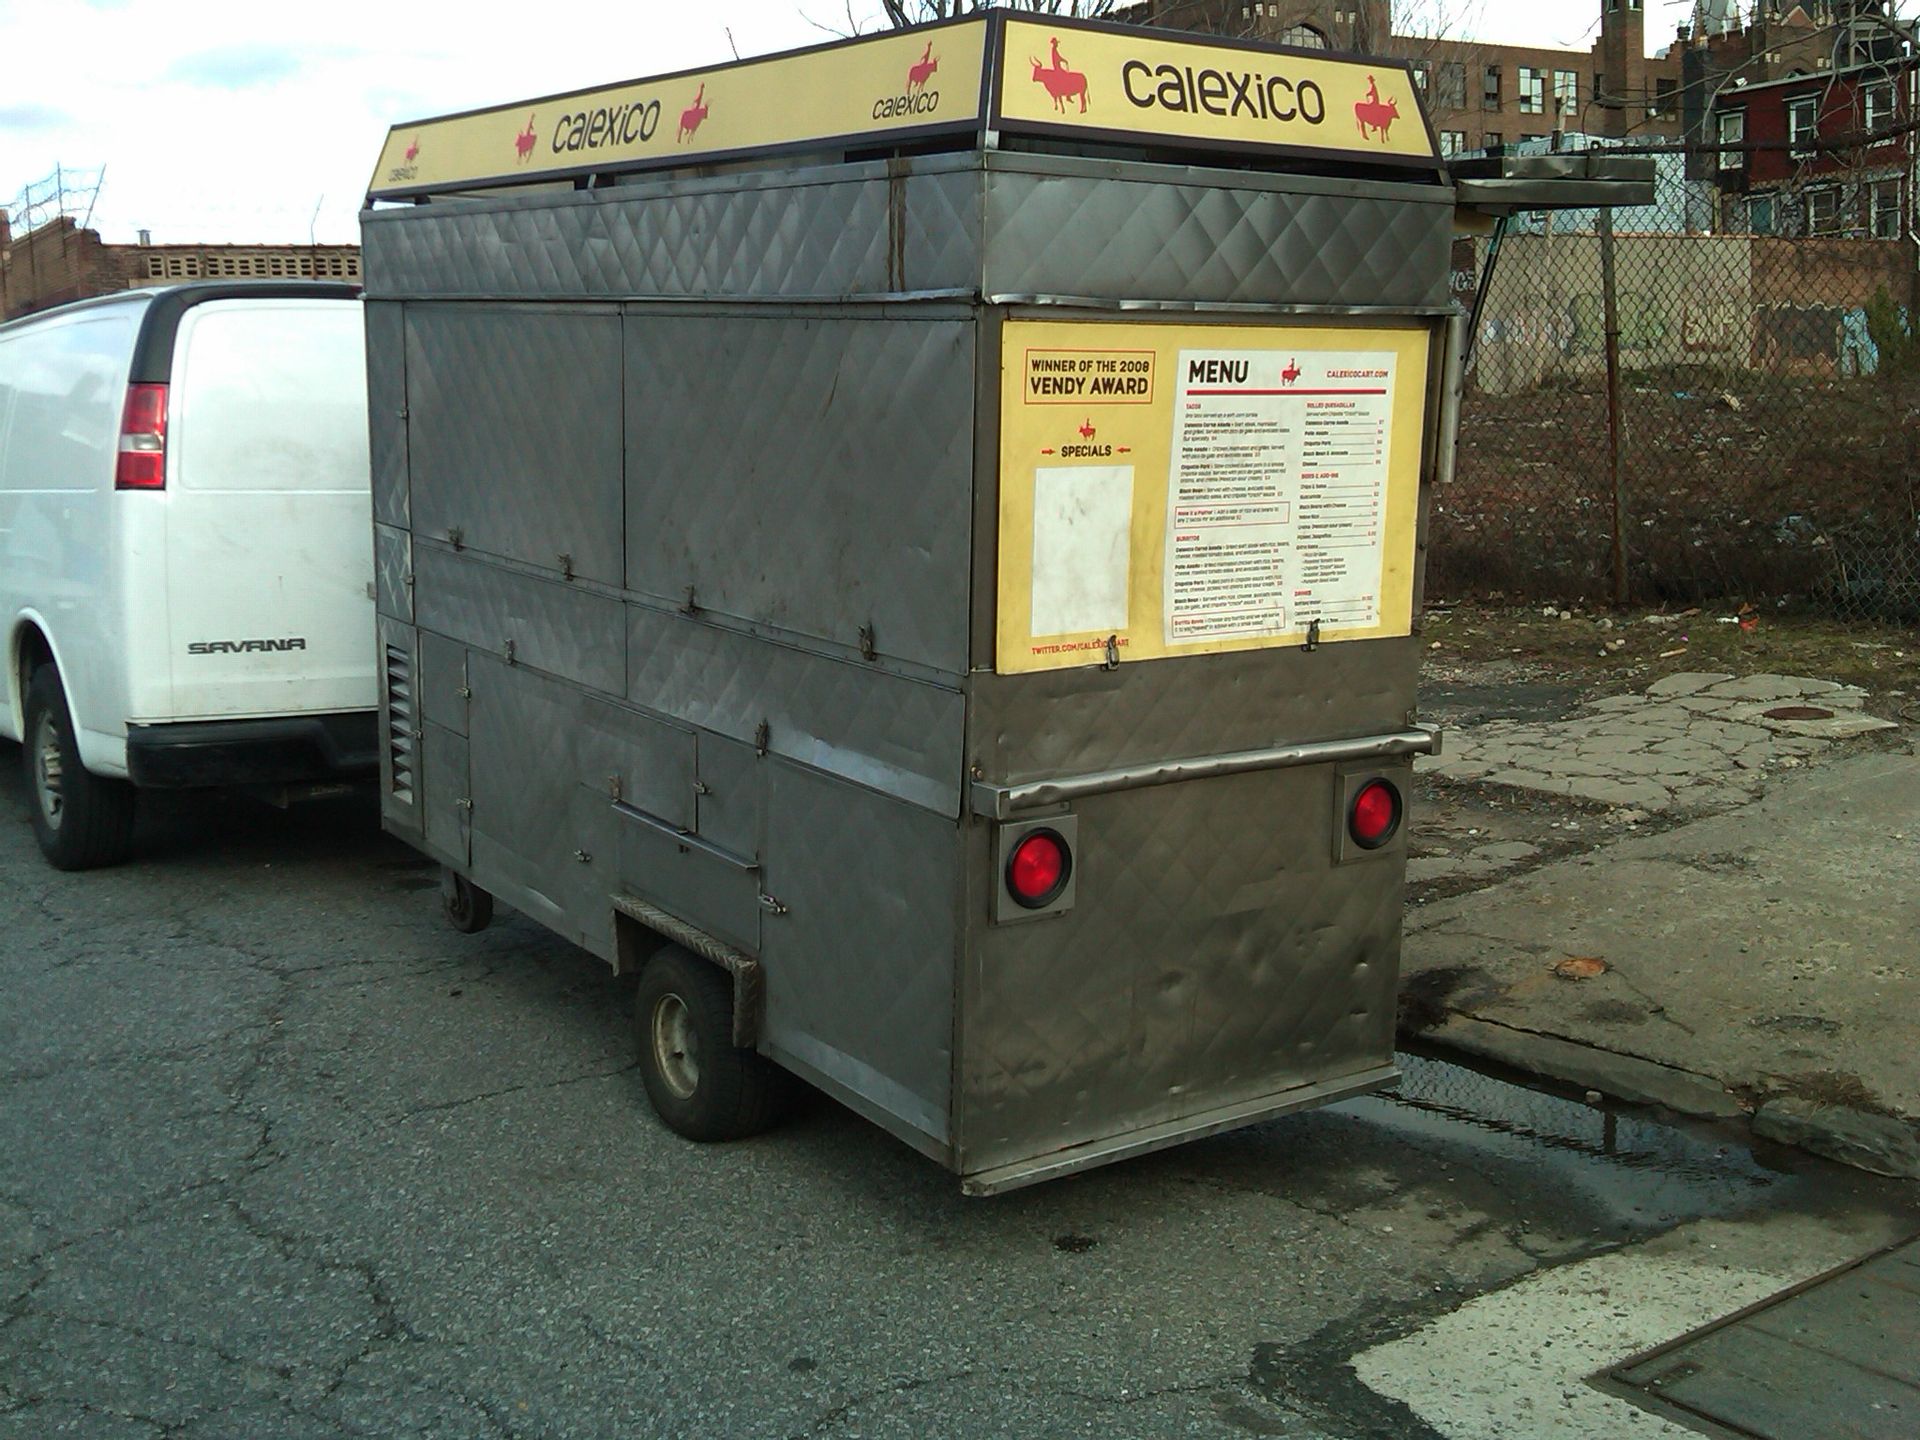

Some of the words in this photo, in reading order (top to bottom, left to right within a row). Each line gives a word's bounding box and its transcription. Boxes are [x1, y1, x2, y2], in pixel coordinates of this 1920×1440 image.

[1122, 59, 1326, 125] calexico
[872, 90, 940, 120] calexico
[552, 99, 661, 154] calexico
[1031, 359, 1076, 373] WINNER
[1078, 359, 1094, 373] OF
[1096, 360, 1117, 373] THE
[1119, 360, 1150, 373] 2008
[1188, 360, 1249, 384] MENU
[1030, 376, 1087, 395] VENDY
[1089, 376, 1149, 395] AWARD
[1061, 444, 1112, 458] SPECIALS
[188, 638, 306, 654] SAVANA
